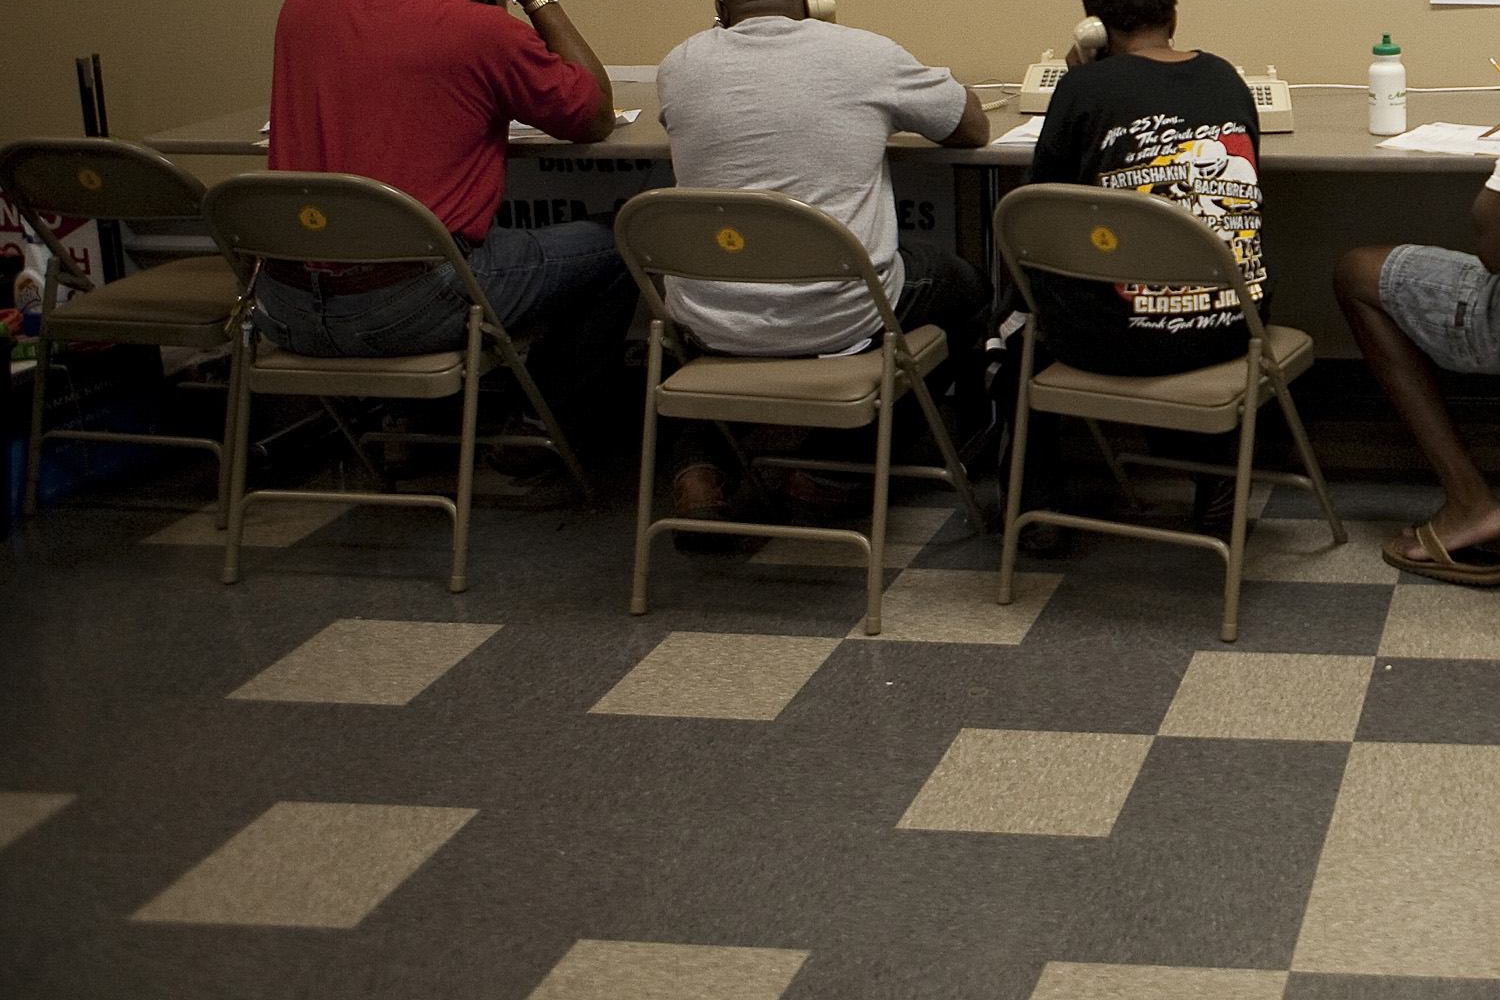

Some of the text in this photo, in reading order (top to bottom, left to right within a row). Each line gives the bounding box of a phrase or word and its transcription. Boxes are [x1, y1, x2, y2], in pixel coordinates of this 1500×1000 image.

[1101, 126, 1127, 150] After
[1129, 116, 1151, 134] 25
[1135, 132, 1159, 148] The
[1160, 128, 1194, 144] Circle
[1195, 125, 1221, 141] City
[1125, 152, 1137, 163] is
[1137, 145, 1161, 162] still
[1134, 293, 1212, 314] CLASSIC
[1128, 315, 1168, 330] Thank
[1168, 317, 1195, 333] God
